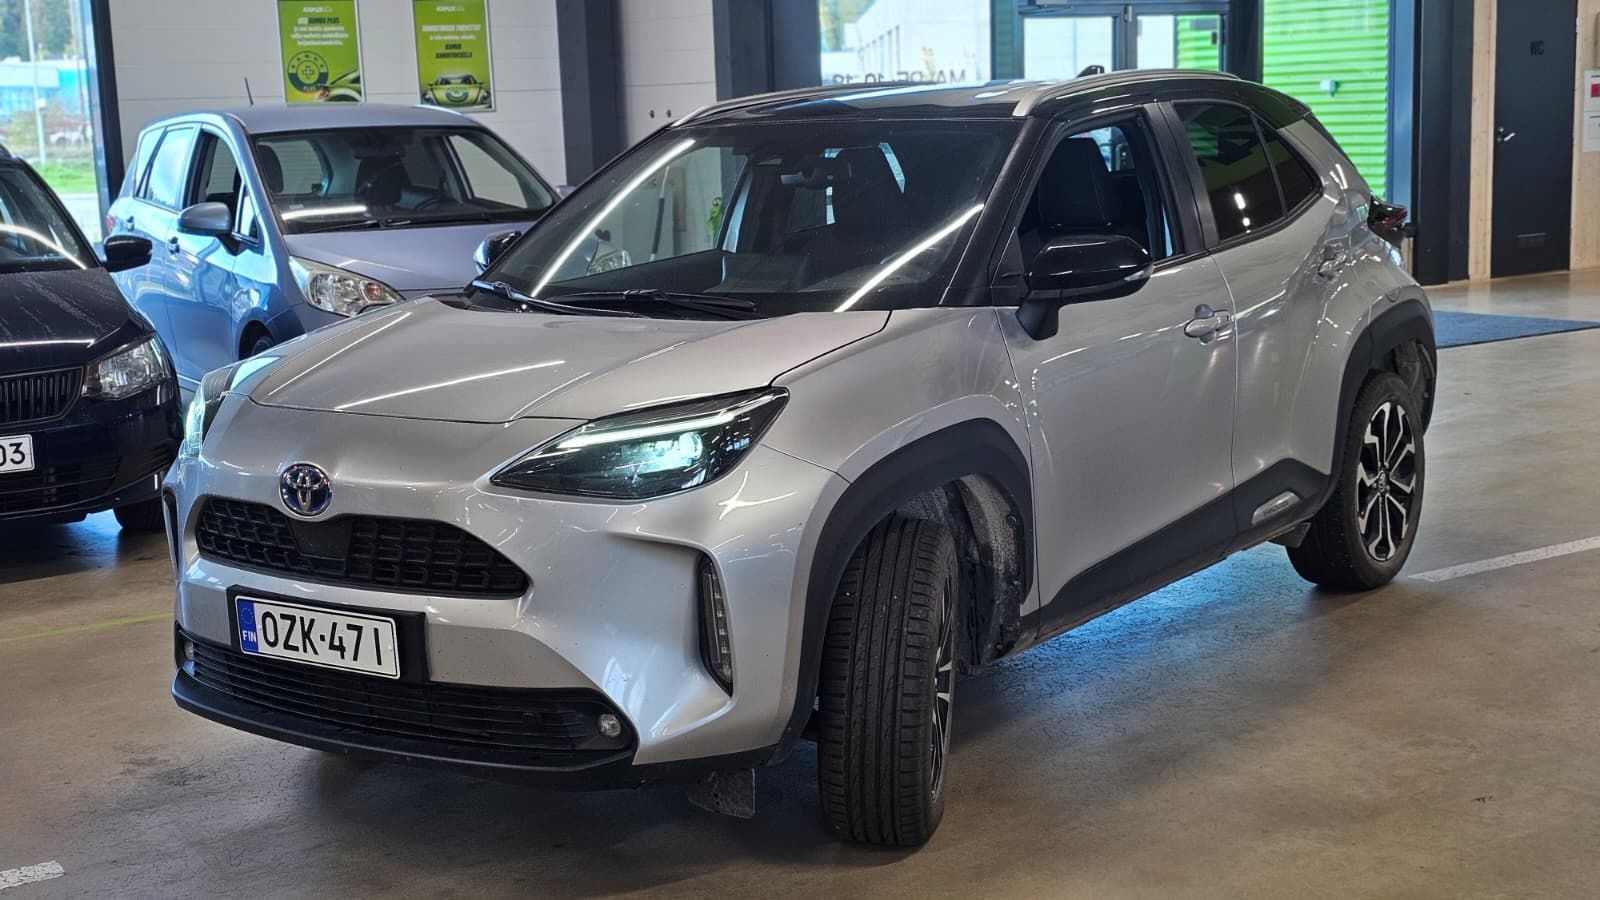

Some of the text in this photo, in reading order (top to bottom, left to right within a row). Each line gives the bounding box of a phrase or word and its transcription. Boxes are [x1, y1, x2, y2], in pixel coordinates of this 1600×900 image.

[1530, 40, 1545, 56] WC
[242, 630, 257, 642] FIN
[261, 611, 382, 666] OZK-471
